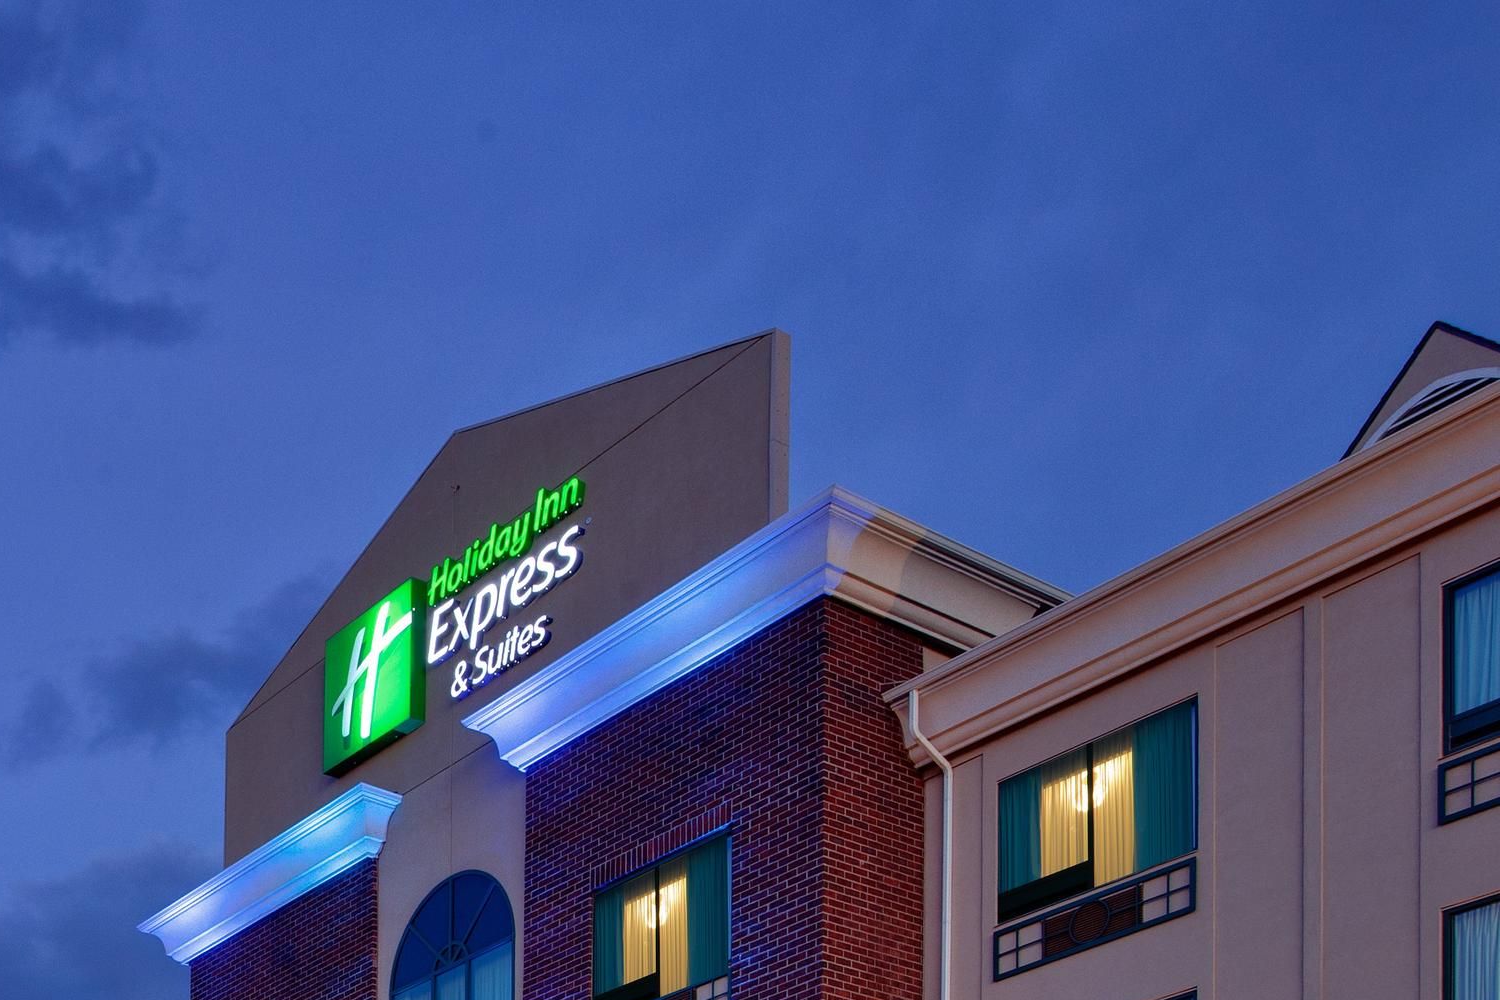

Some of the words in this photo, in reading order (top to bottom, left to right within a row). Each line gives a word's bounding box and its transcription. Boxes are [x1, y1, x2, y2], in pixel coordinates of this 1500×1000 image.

[427, 525, 581, 665] Express
[428, 510, 532, 605] Holiday
[533, 476, 583, 532] Inn
[450, 660, 470, 698] &
[472, 615, 549, 685] Suites
